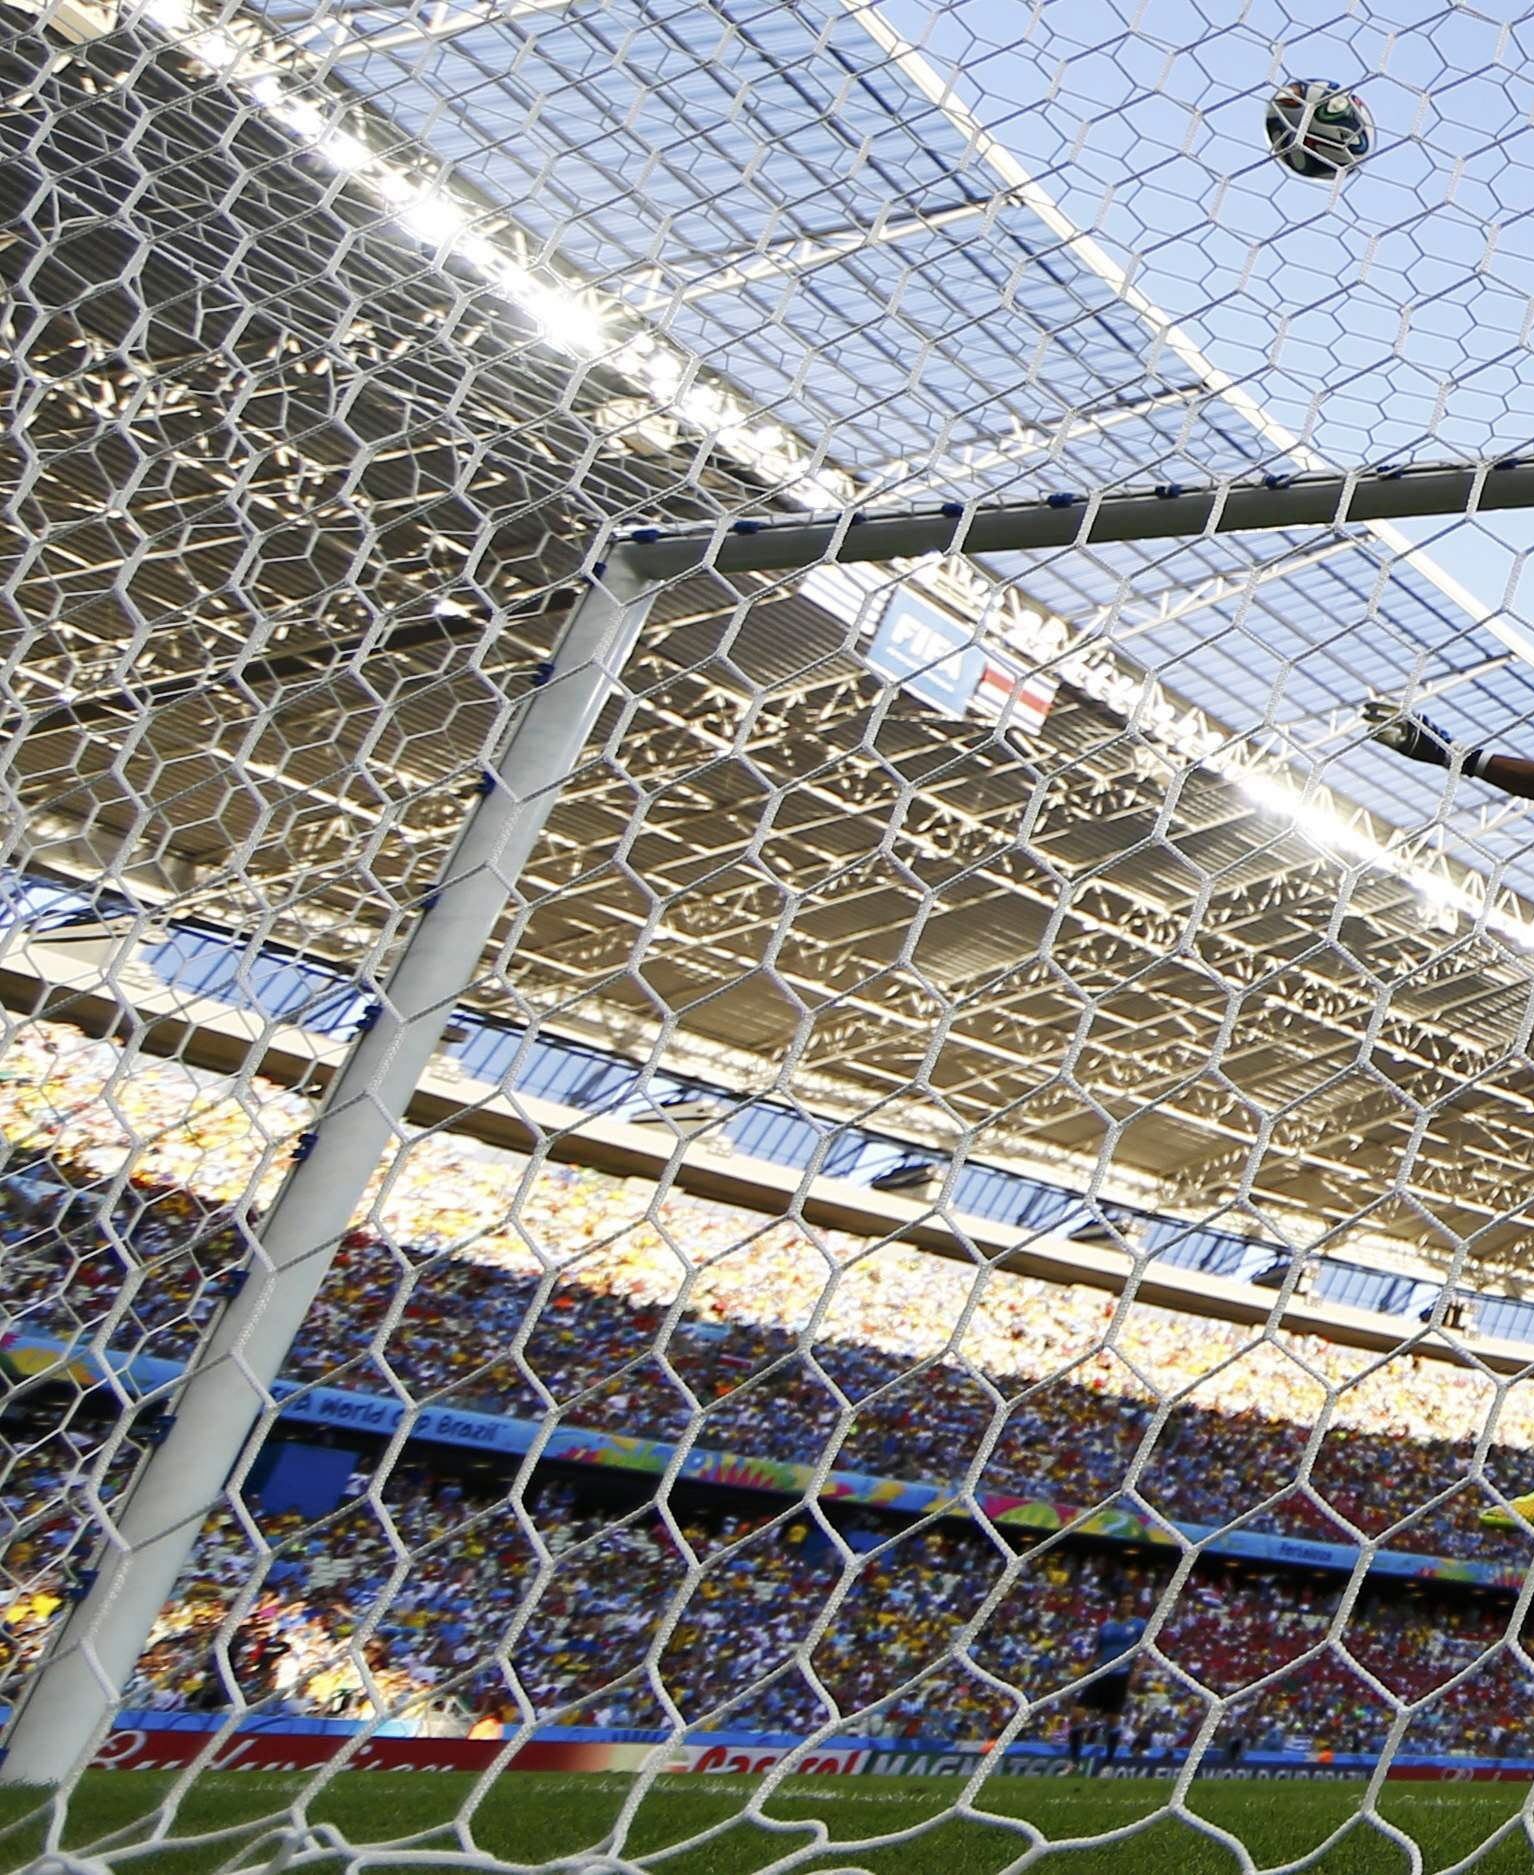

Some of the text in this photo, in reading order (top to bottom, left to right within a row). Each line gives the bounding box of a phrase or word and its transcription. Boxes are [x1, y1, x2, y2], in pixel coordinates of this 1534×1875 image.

[891, 612, 963, 680] FIFA
[320, 1396, 387, 1424] World
[391, 1408, 431, 1431] Cp
[692, 1746, 864, 1775] Casrol
[871, 1754, 1074, 1777] MAGNTEC
